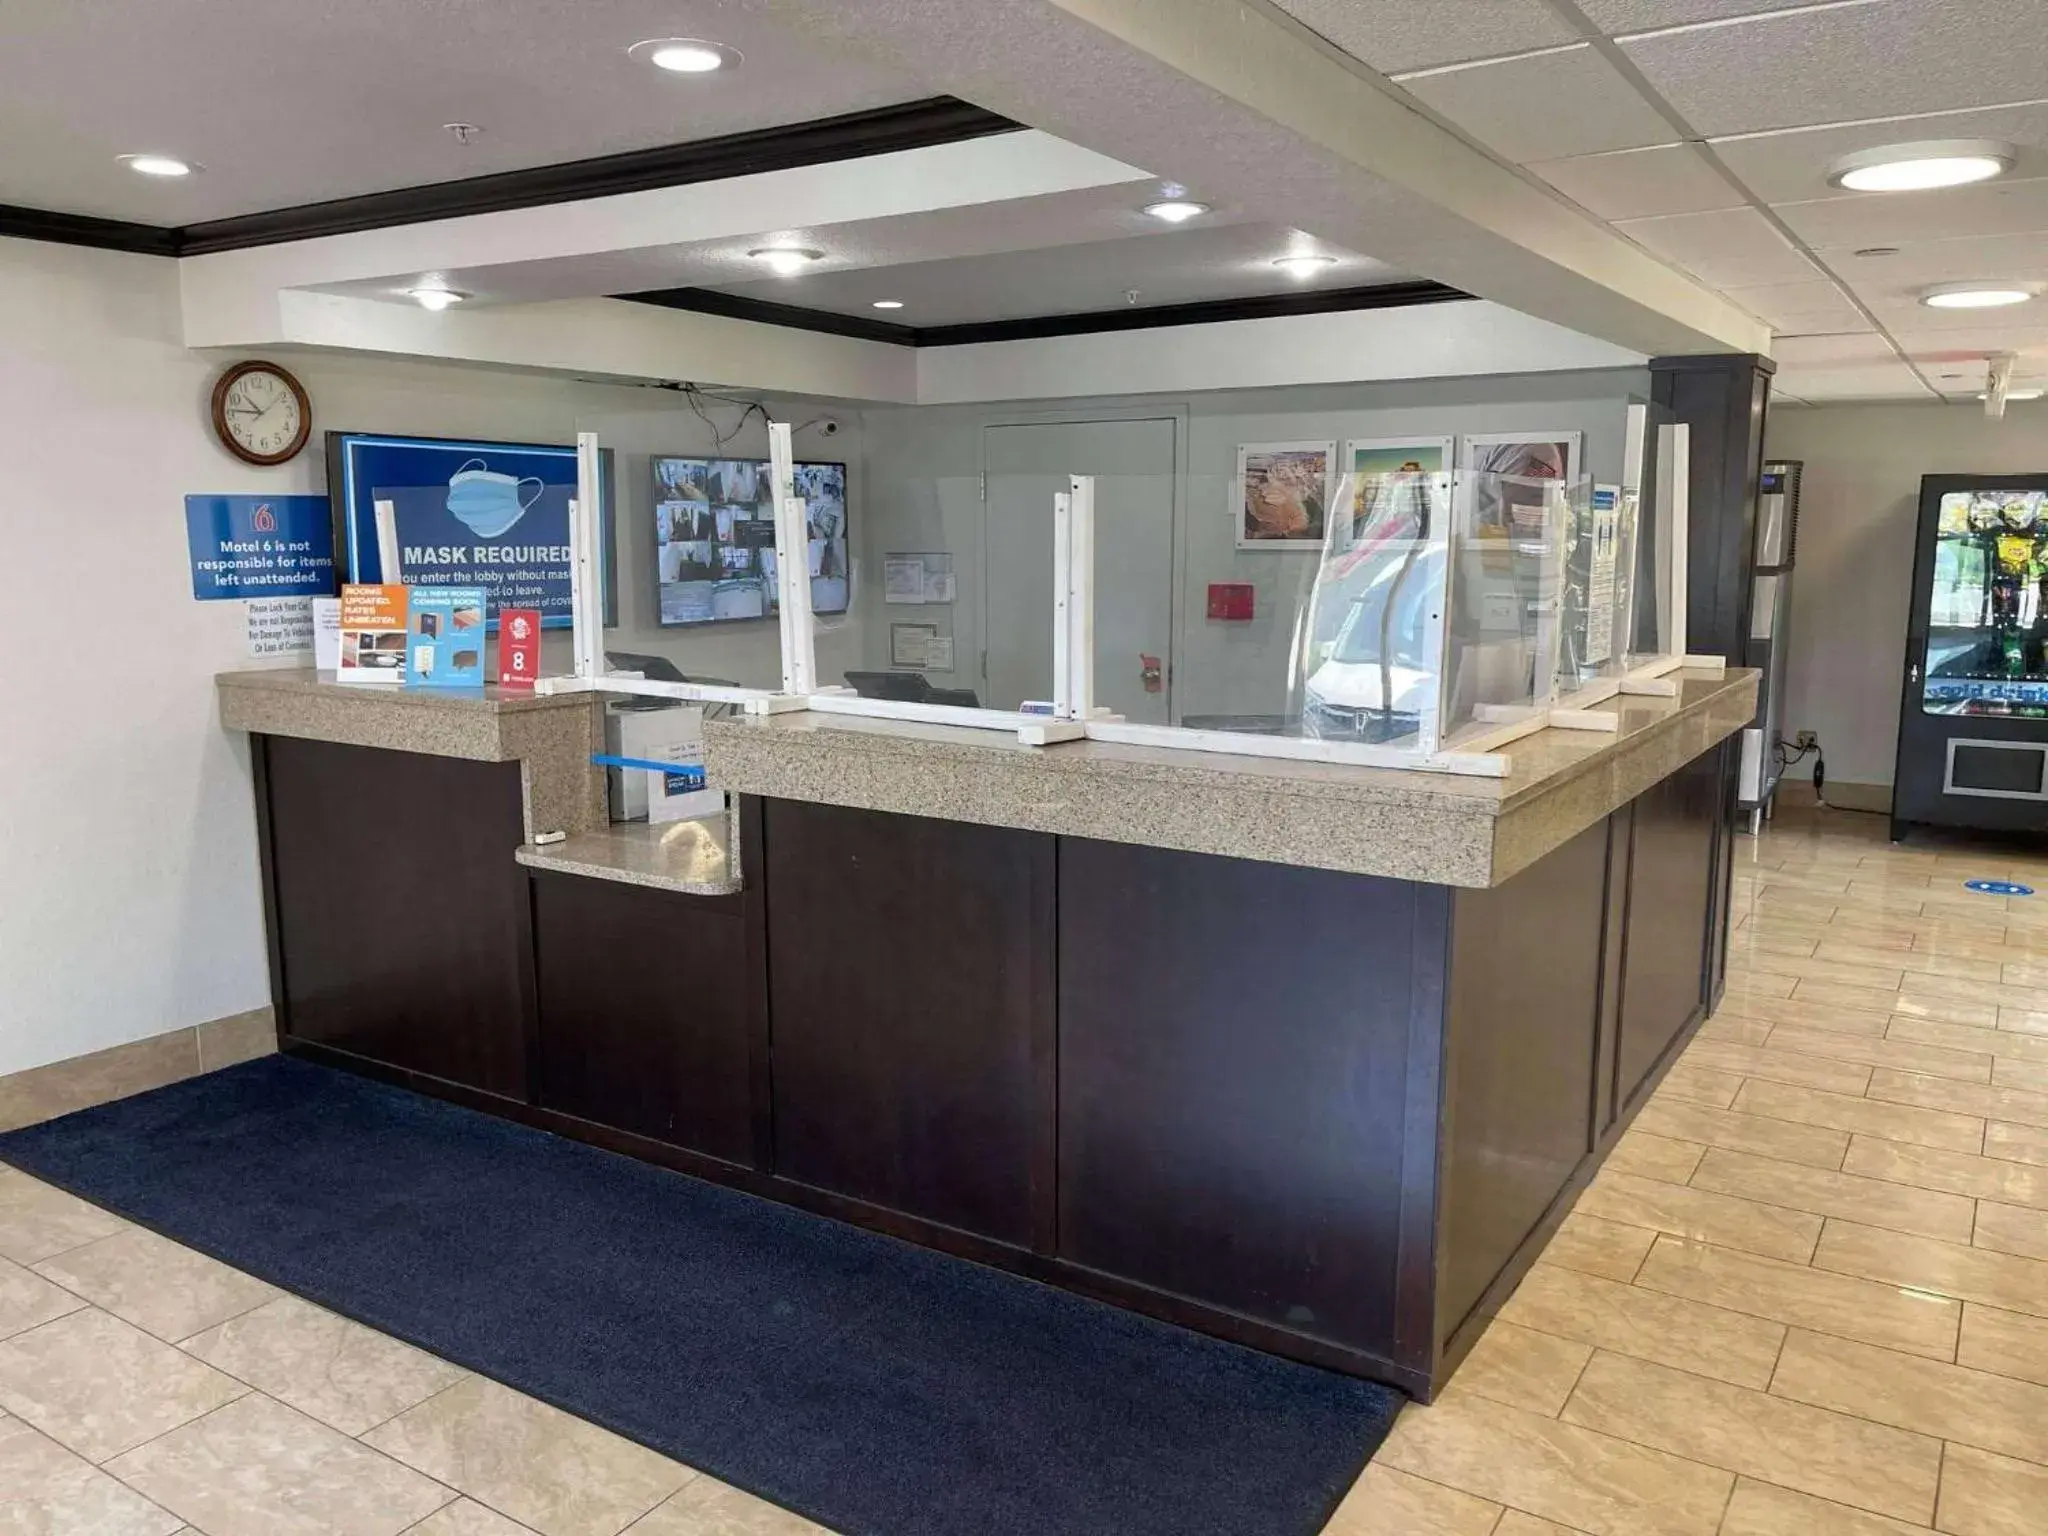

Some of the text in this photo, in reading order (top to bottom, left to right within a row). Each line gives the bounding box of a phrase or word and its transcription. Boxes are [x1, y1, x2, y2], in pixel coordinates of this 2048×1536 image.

[229, 393, 241, 406] 10
[220, 540, 311, 553] Motel 6 is not
[404, 545, 571, 564] MASK REQUIRED
[198, 557, 274, 572] responsible
[278, 555, 296, 567] for
[215, 572, 320, 586] left unattended.
[402, 572, 418, 584] ou
[421, 571, 451, 584] enter
[453, 570, 472, 582] the
[474, 570, 503, 585] lobby
[507, 569, 546, 582] without
[515, 584, 545, 596] leave.
[513, 651, 525, 671] 8
